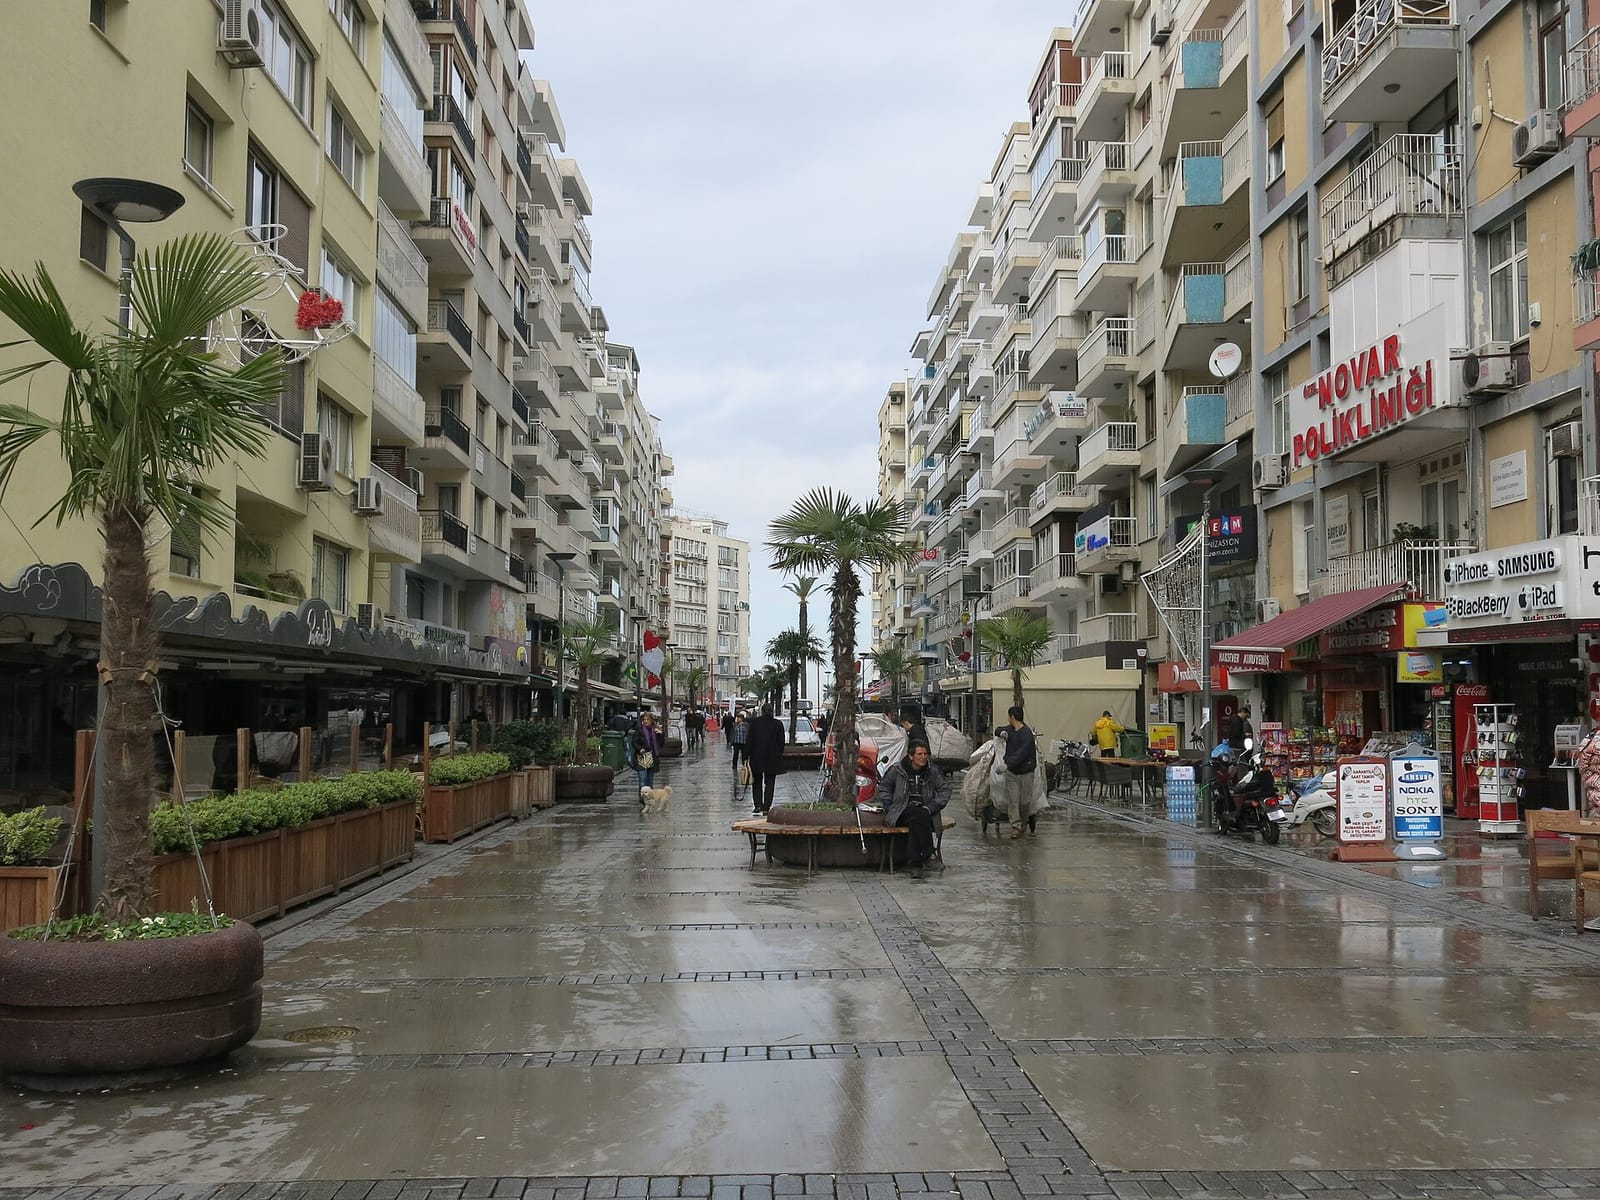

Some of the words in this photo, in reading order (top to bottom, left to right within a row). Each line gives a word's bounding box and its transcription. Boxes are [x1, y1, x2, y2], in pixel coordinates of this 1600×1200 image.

[1318, 335, 1401, 411] NOVAR
[1293, 359, 1434, 468] POLİKLİNİĞİ
[1455, 562, 1488, 582] iPhone
[1498, 550, 1555, 577] SAMSUNG
[1457, 595, 1510, 616] BlackBerry
[1531, 585, 1556, 607] iPad
[1328, 608, 1397, 634] KSEVER
[1396, 807, 1438, 815] SONY
